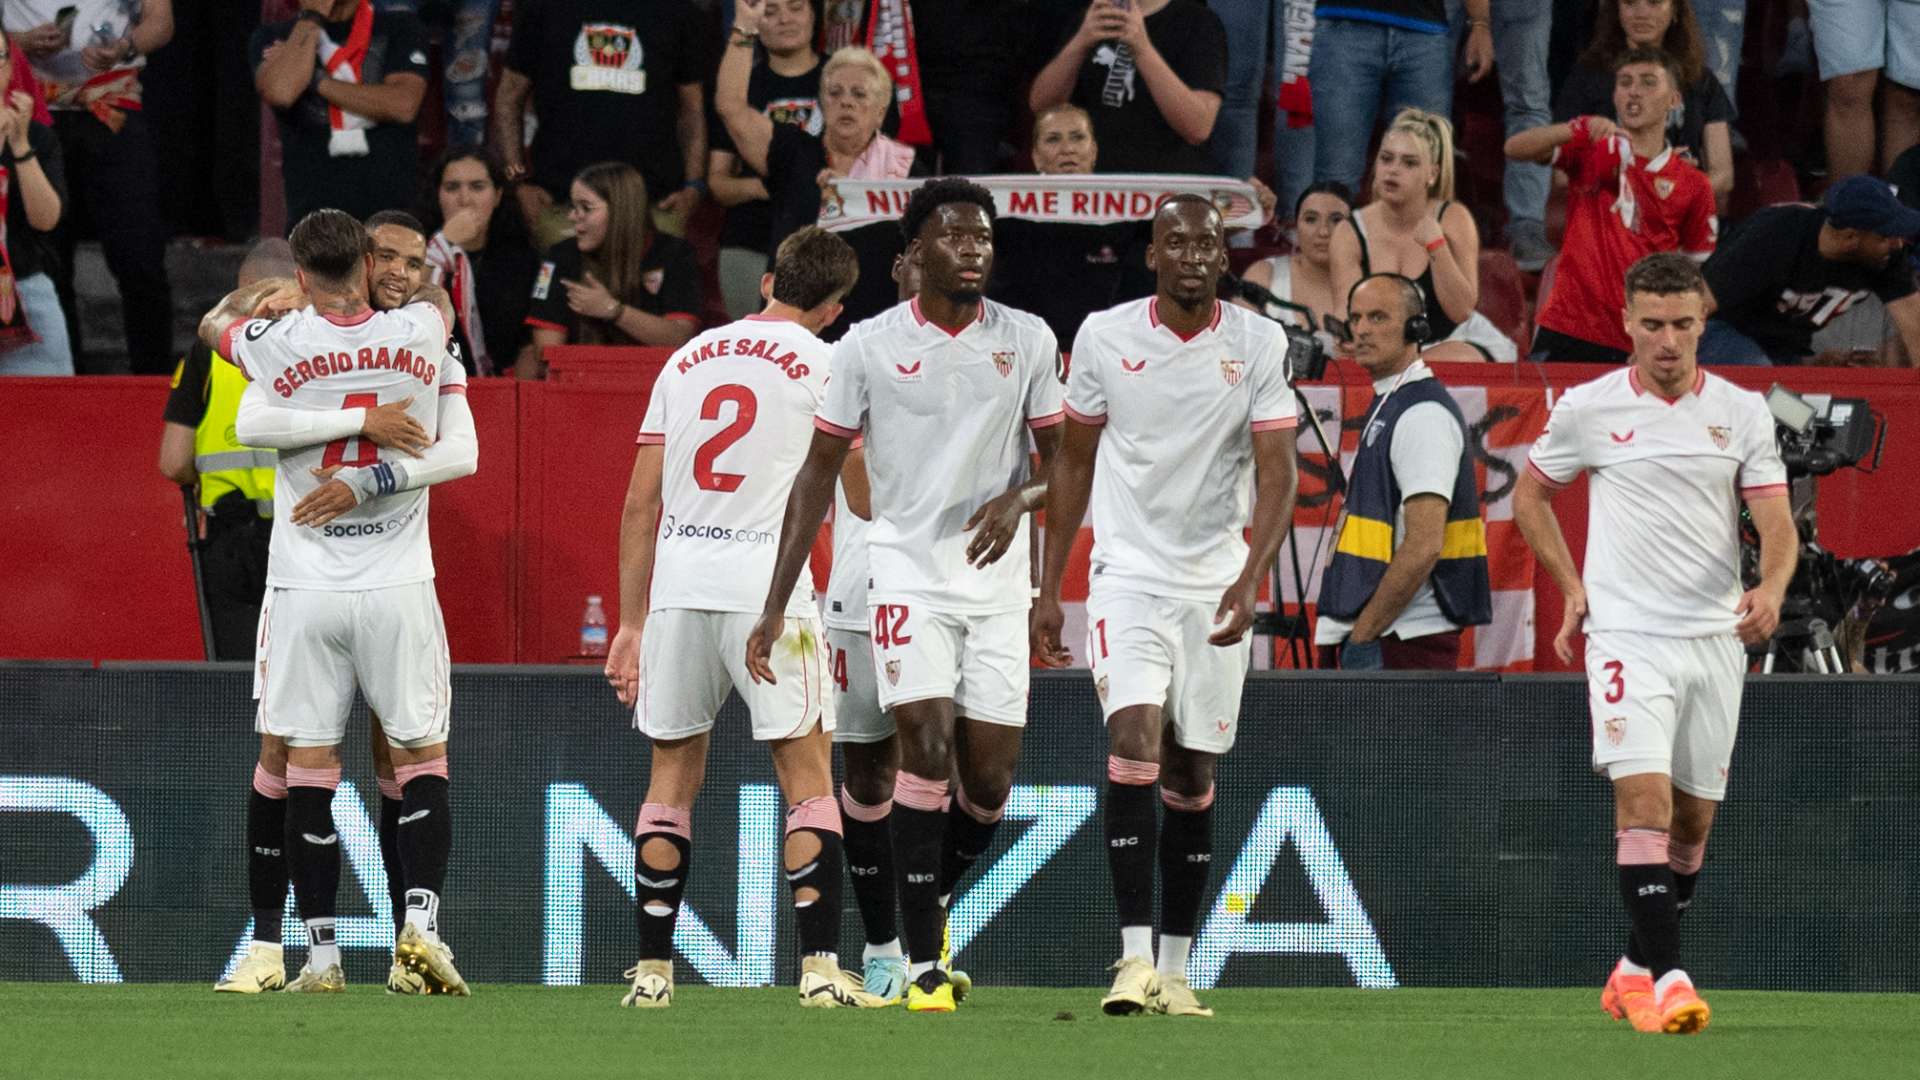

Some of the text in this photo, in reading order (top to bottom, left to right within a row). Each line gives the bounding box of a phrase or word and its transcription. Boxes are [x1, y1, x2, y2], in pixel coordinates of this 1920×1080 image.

[1008, 191, 1059, 215] ME
[273, 347, 436, 399] SERGIO RAMOS
[676, 338, 810, 380] KIKE SALAS
[321, 392, 383, 468] 4
[693, 383, 758, 493] 2
[875, 604, 912, 650] 42
[1603, 660, 1625, 704] 3
